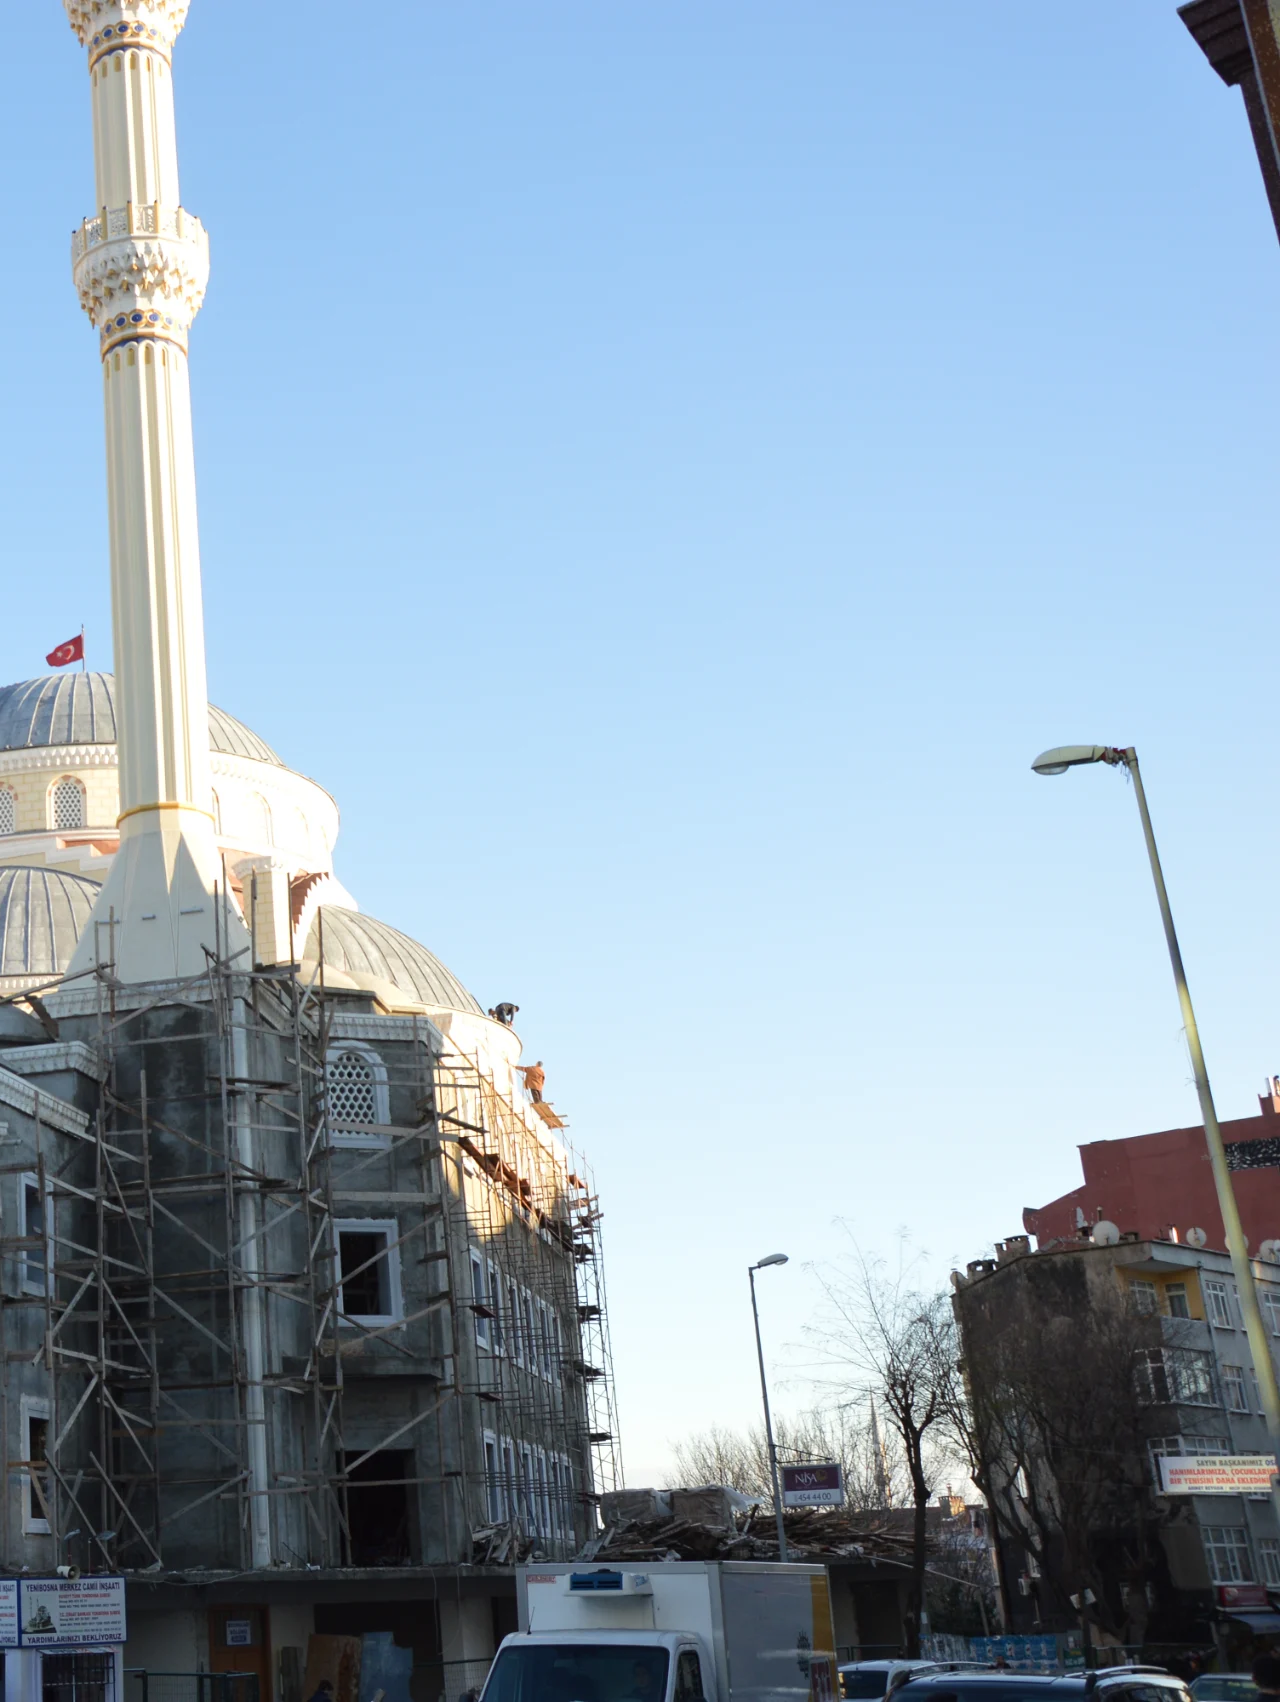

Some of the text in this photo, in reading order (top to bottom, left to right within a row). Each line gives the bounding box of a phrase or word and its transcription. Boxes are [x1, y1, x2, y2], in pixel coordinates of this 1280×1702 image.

[26, 1582, 58, 1592] YENİBOSNA
[59, 1582, 81, 1592] MERKEZ
[27, 1632, 122, 1644] YARDIMLARINIZI BEKLİYORUZ
